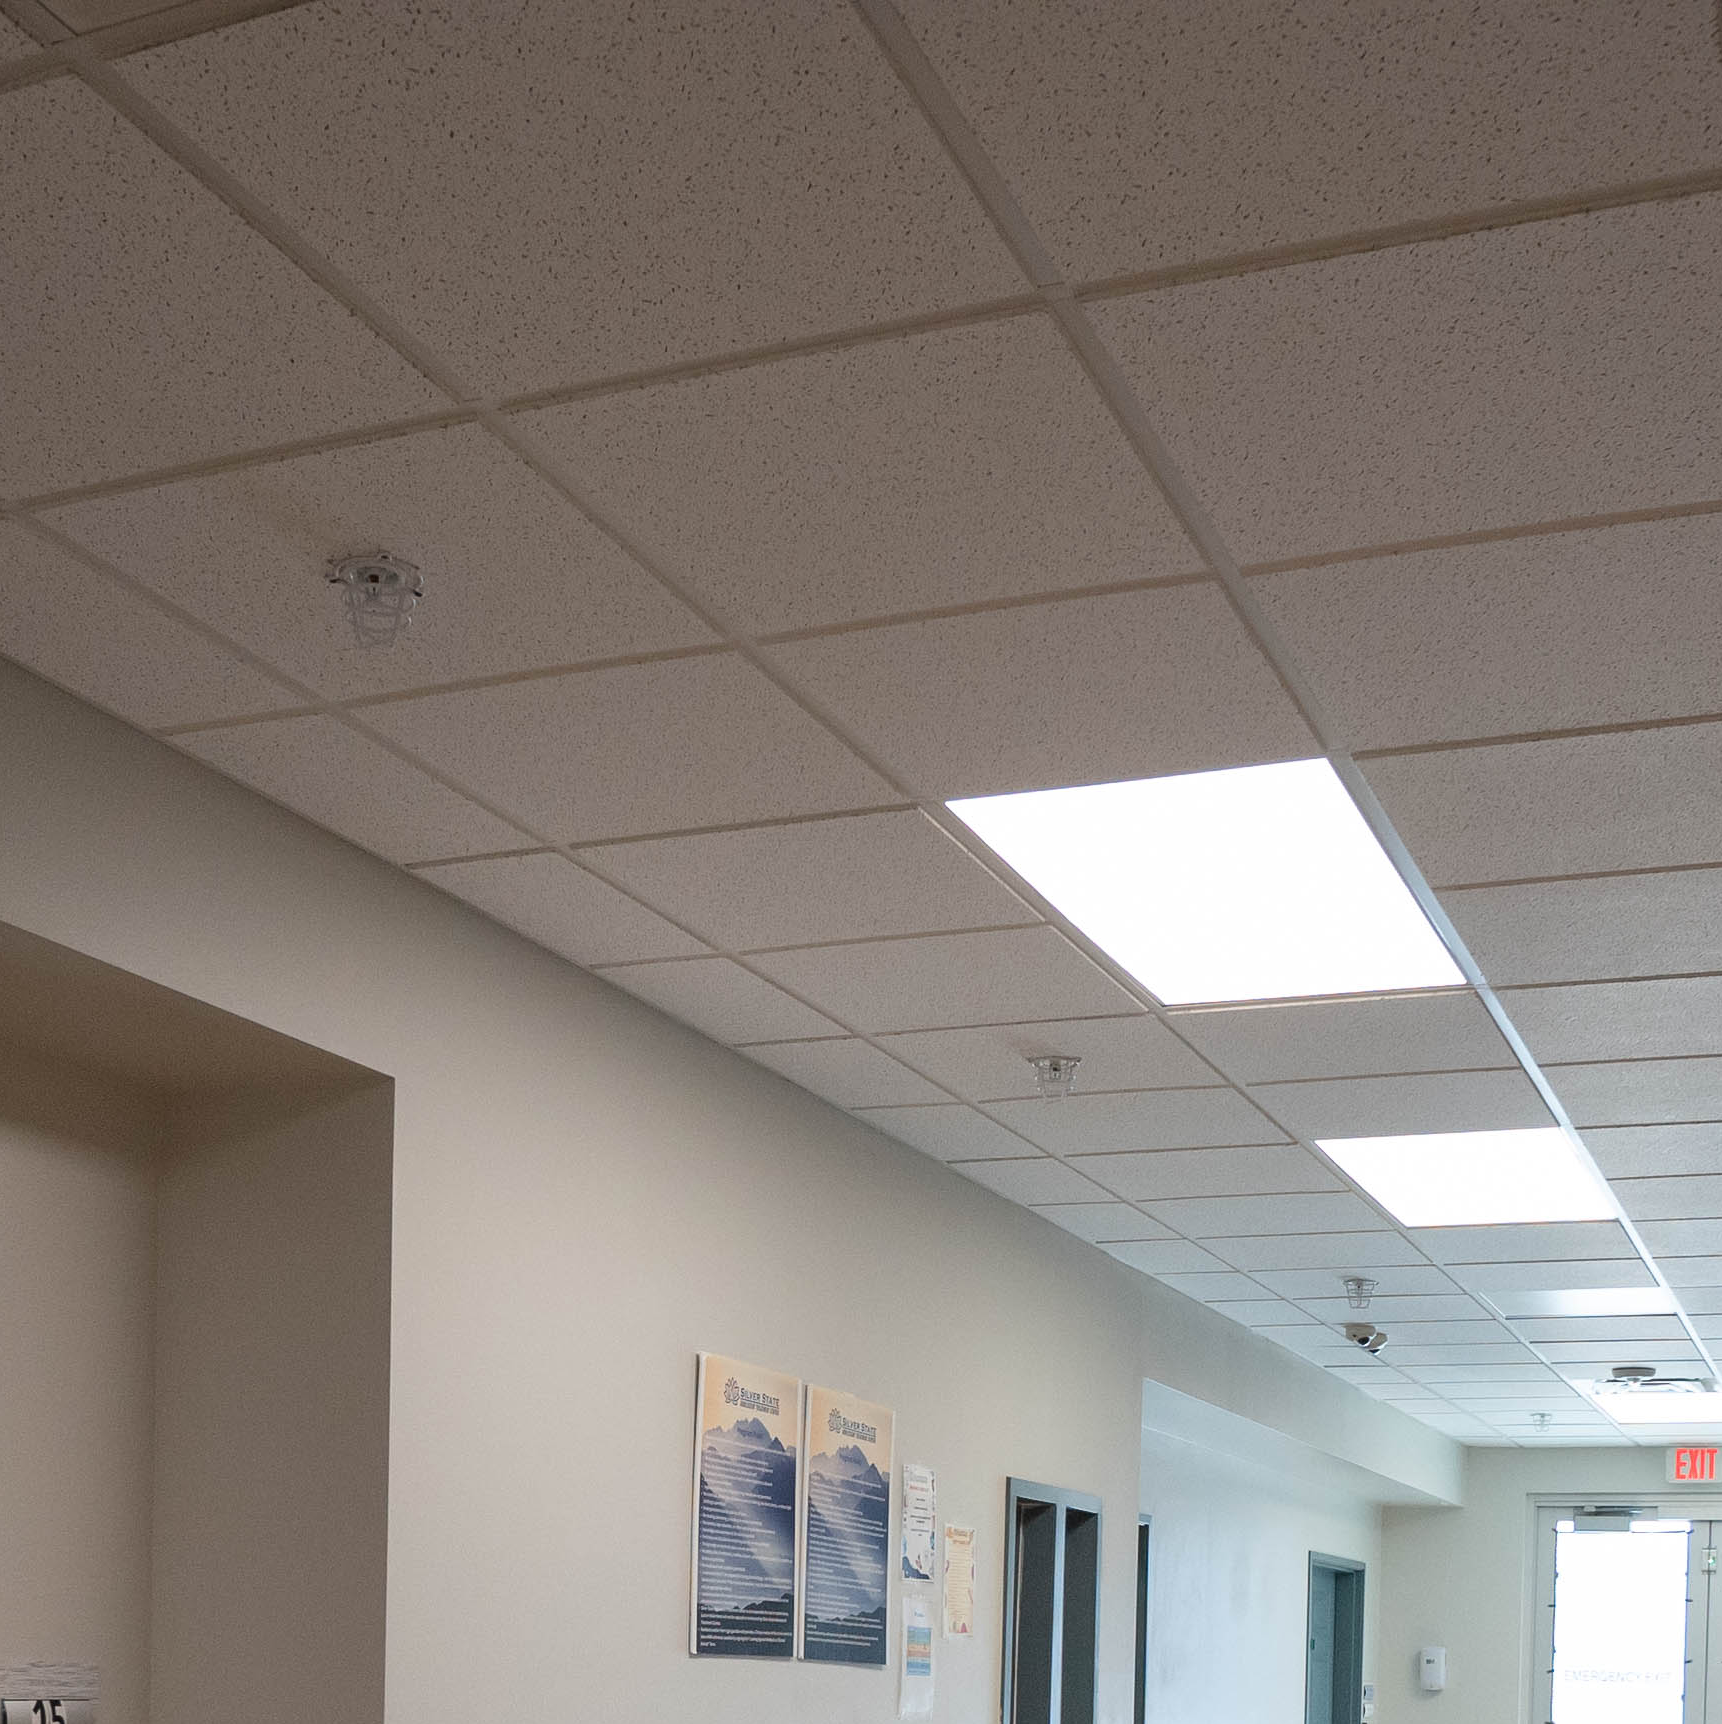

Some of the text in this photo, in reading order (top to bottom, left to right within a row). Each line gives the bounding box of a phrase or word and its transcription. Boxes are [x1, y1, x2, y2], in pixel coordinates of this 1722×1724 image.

[762, 1393, 779, 1407] STATE
[861, 1423, 877, 1436] STATE
[1675, 1448, 1718, 1480] EXIT
[1564, 1670, 1642, 1682] EMERGENCY
